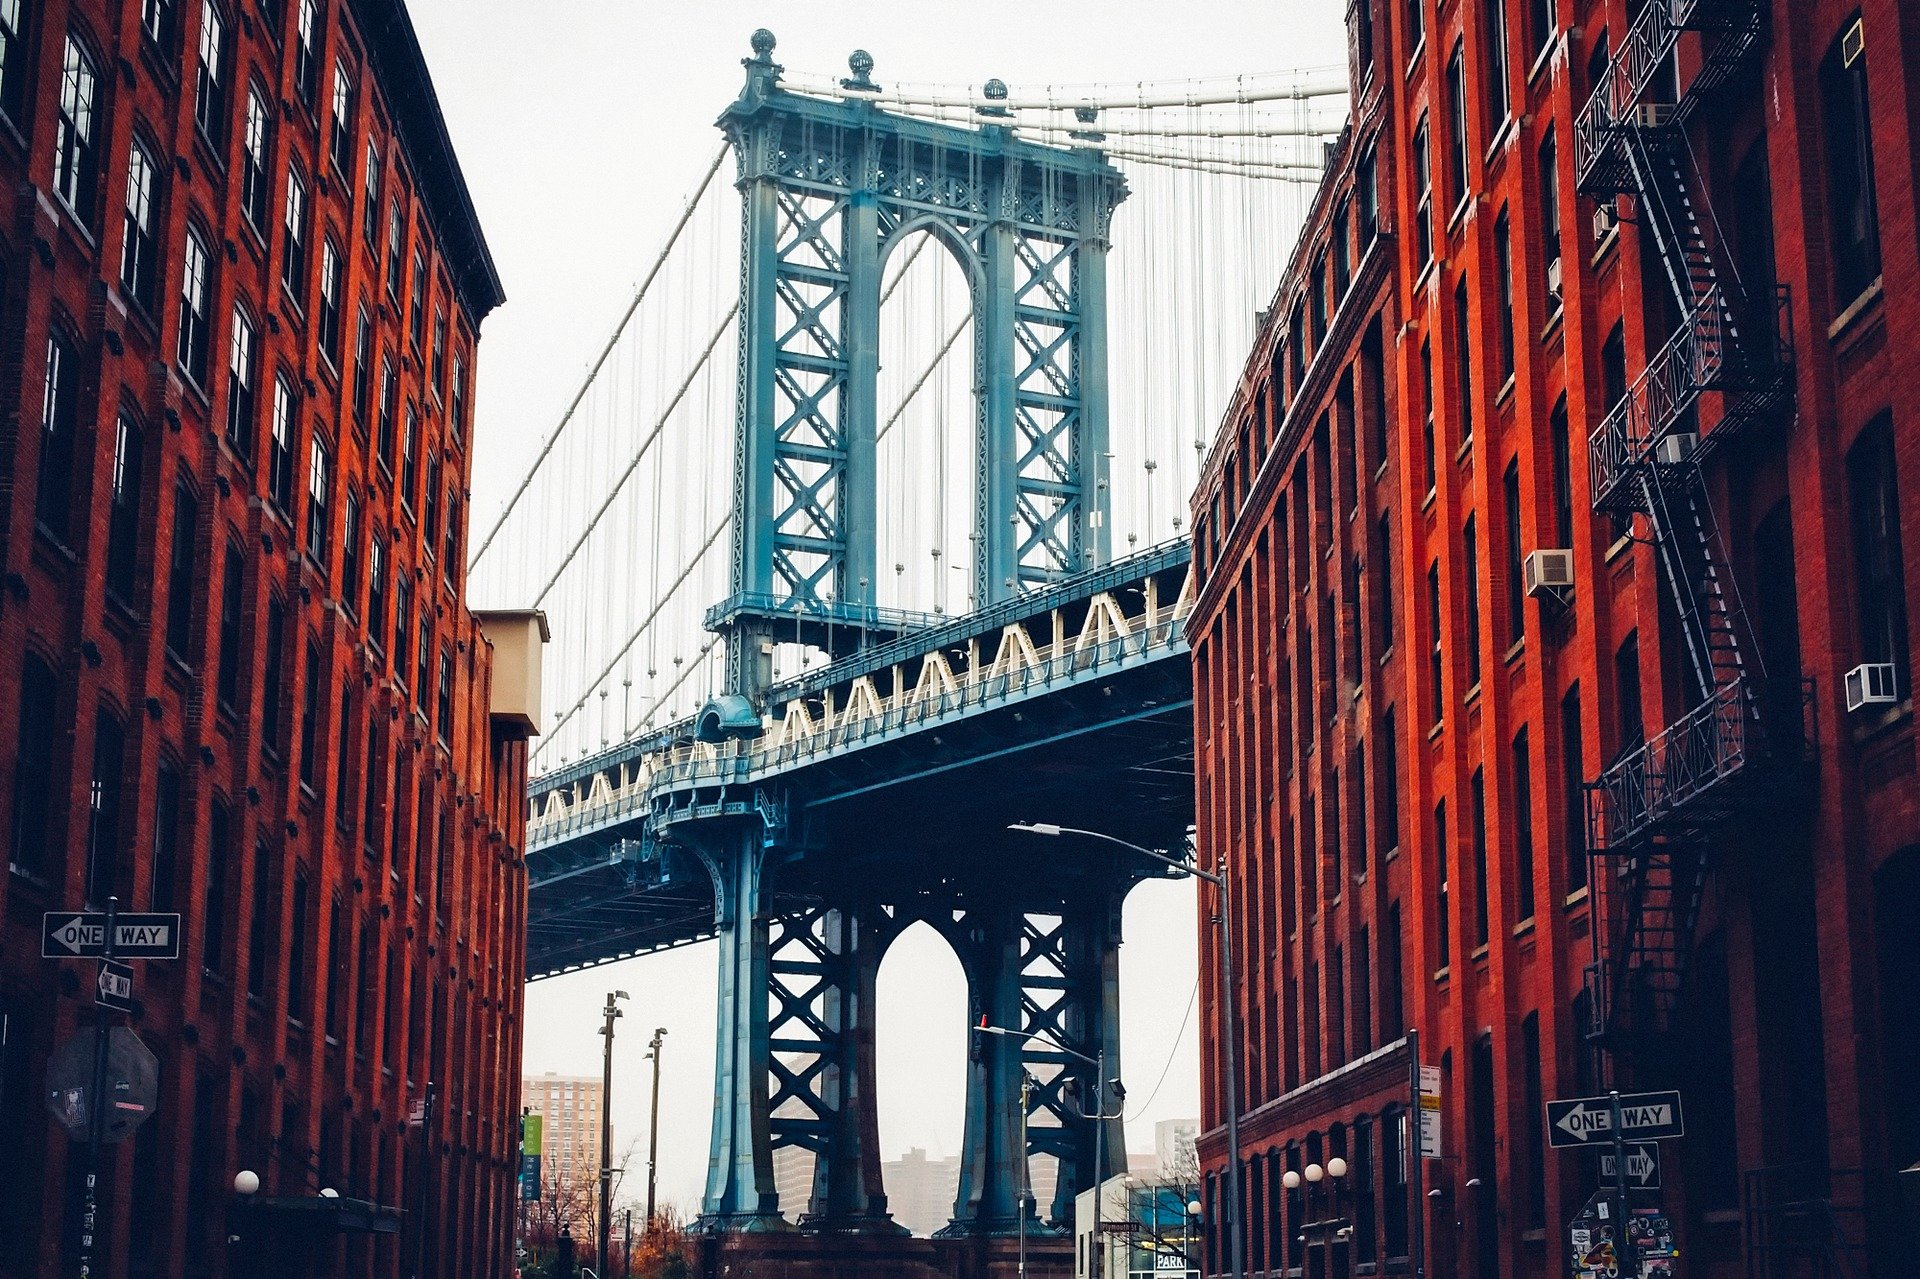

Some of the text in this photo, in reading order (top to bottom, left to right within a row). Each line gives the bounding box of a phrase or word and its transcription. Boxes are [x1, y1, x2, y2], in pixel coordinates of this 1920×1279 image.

[65, 927, 161, 944] ONE WAY
[102, 973, 129, 995] ONE WAY
[1569, 1106, 1662, 1131] ONE WAY
[1629, 1157, 1649, 1174] WAY
[526, 1157, 535, 1198] Mellon
[1101, 1223, 1138, 1233] Plymouth St
[1157, 1255, 1184, 1267] PARK
